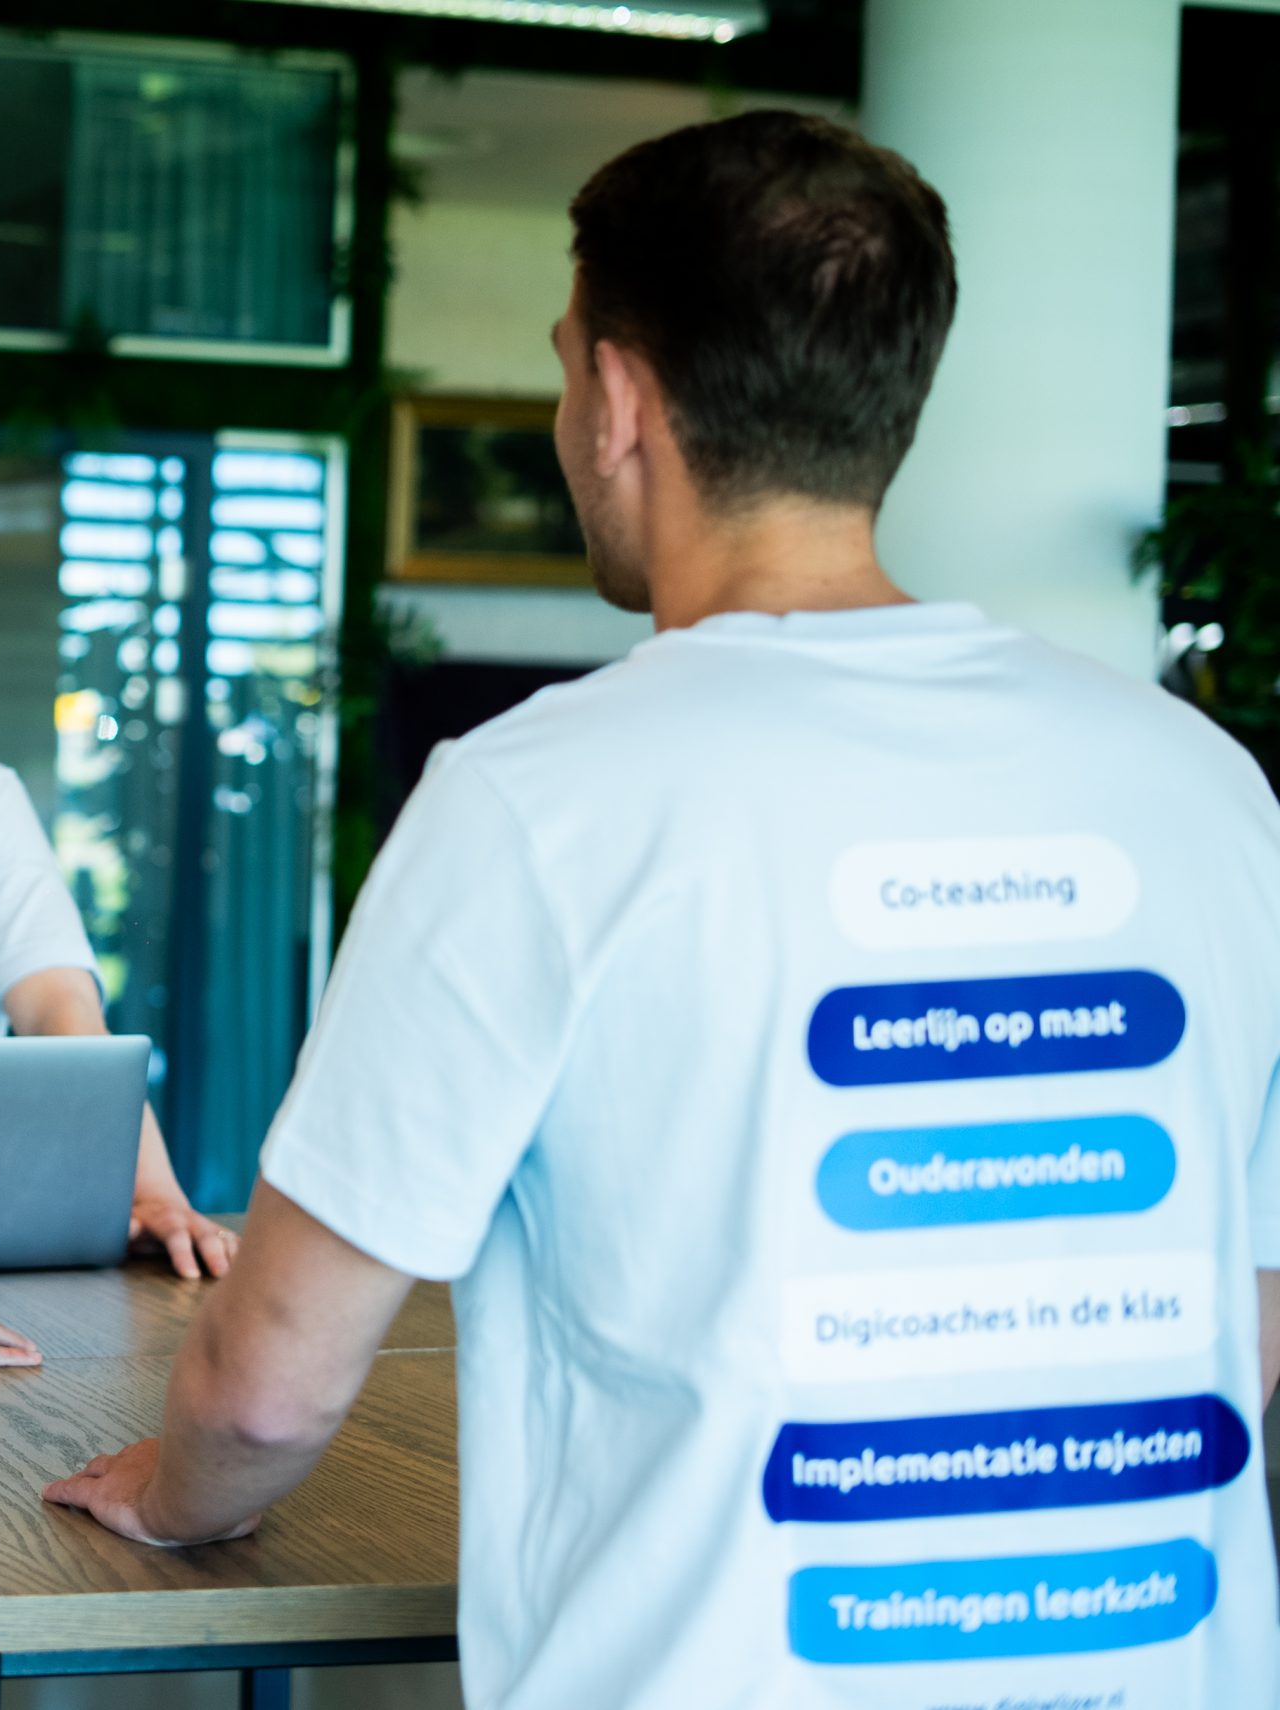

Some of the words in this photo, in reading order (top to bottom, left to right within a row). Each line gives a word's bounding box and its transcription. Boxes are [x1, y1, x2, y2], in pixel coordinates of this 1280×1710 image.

[880, 872, 1077, 910] Co-teaching
[852, 1007, 980, 1052] Leerlijn
[984, 1011, 1034, 1048] op
[1039, 1001, 1127, 1040] maat
[868, 1143, 1126, 1196] Ouderavonden
[815, 1301, 1017, 1347] Digicoaches
[1027, 1298, 1060, 1328] in
[1071, 1294, 1110, 1325] de
[1121, 1290, 1182, 1322] klas
[792, 1435, 1058, 1494] Implementatie
[1063, 1428, 1203, 1476] trajecten
[829, 1587, 1029, 1632] Trainingen
